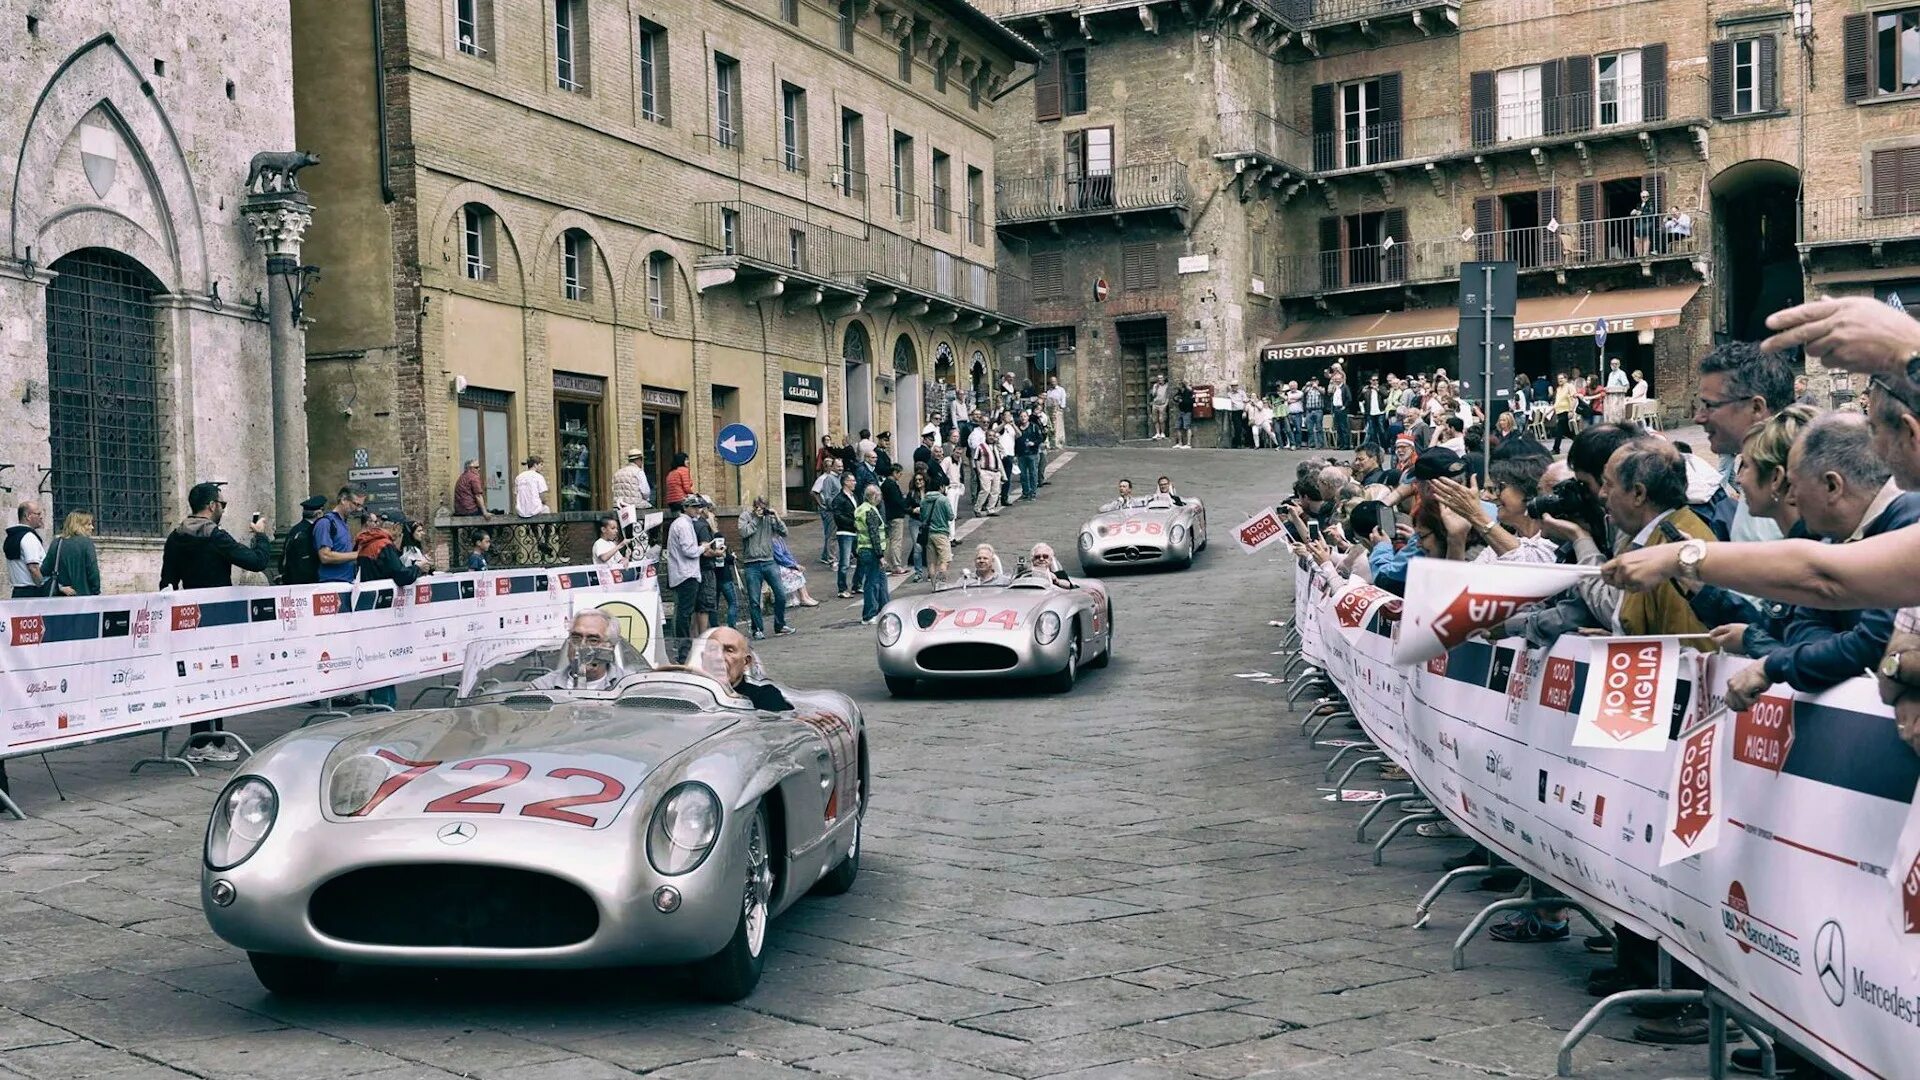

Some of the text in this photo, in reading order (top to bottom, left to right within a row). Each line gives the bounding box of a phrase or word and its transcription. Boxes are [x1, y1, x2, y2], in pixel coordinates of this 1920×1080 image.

[1267, 318, 1635, 360] RISTORANTE PIZZERIA PADAFOTE
[788, 386, 819, 399] GELATERIA
[797, 377, 810, 387] BAR
[1245, 517, 1271, 536] 1000
[1250, 524, 1279, 545] MIGLIA
[151, 609, 163, 621] 2015
[1350, 590, 1383, 622] MIGL
[19, 618, 38, 630] 1000
[1552, 662, 1570, 682] 1000
[1604, 651, 1632, 716] 1000
[1630, 646, 1659, 722] MIGLIA
[1751, 702, 1784, 729] 1000
[1743, 734, 1780, 764] MIGLIA
[349, 747, 626, 828] 722
[1680, 745, 1697, 819] 1000
[1696, 730, 1714, 816] MIGLIA
[1852, 966, 1920, 1028] Mercedes-
